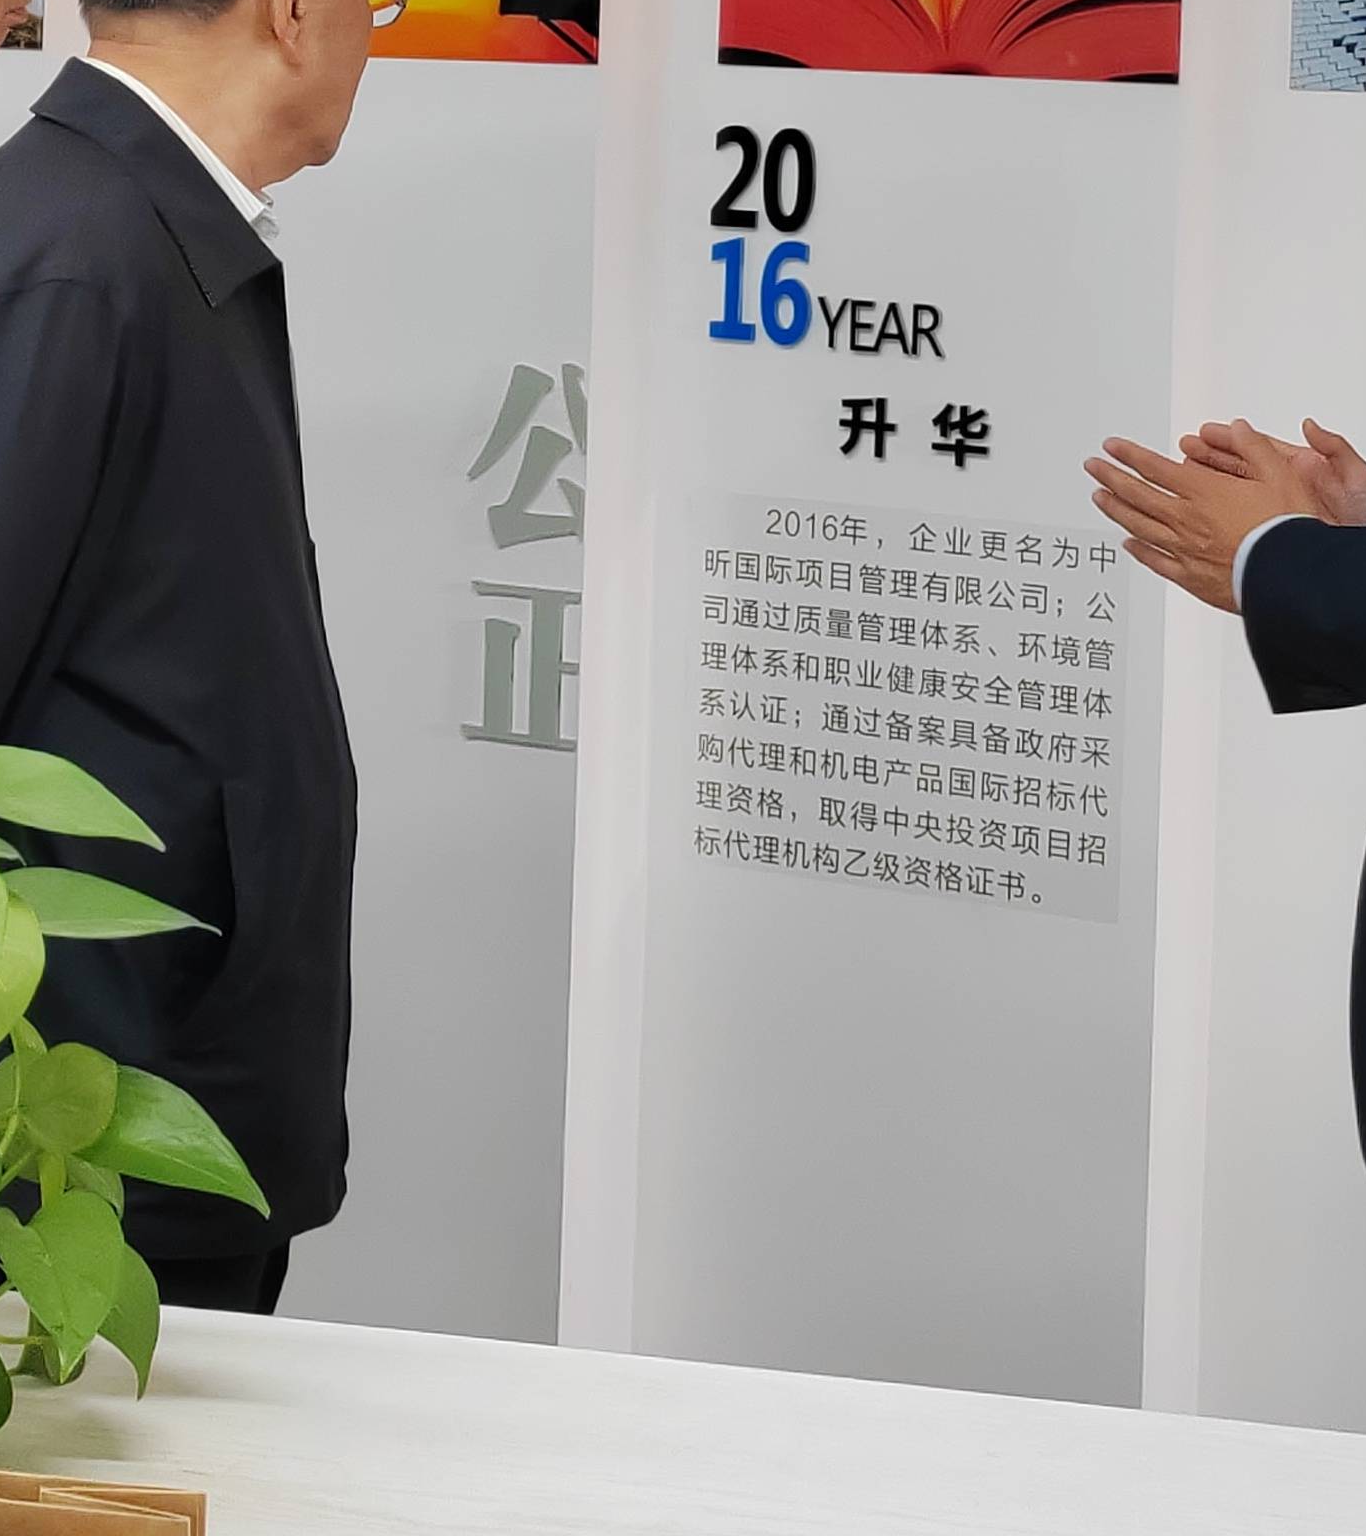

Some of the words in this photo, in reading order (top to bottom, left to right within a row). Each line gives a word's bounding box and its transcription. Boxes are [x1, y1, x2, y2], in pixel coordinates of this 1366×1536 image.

[710, 124, 816, 233] 20
[708, 237, 813, 347] 16
[818, 295, 946, 361] YEAR
[766, 508, 1116, 574] 2016年，企业更名为中
[704, 549, 1116, 623] 昕国际项目管理有限公司；公
[702, 595, 1114, 672] 司通过质量管理体系、环境管
[701, 642, 1113, 719] 理体系和职业健康安全管理体
[699, 688, 1111, 767] 系认证；通过备案具备政府采
[697, 734, 1108, 817] 购代理和机电产品国际招标代
[695, 780, 1106, 866] 理资格，取得中央投资项目招
[693, 826, 1043, 904] 标代理机构乙级资格证书。
